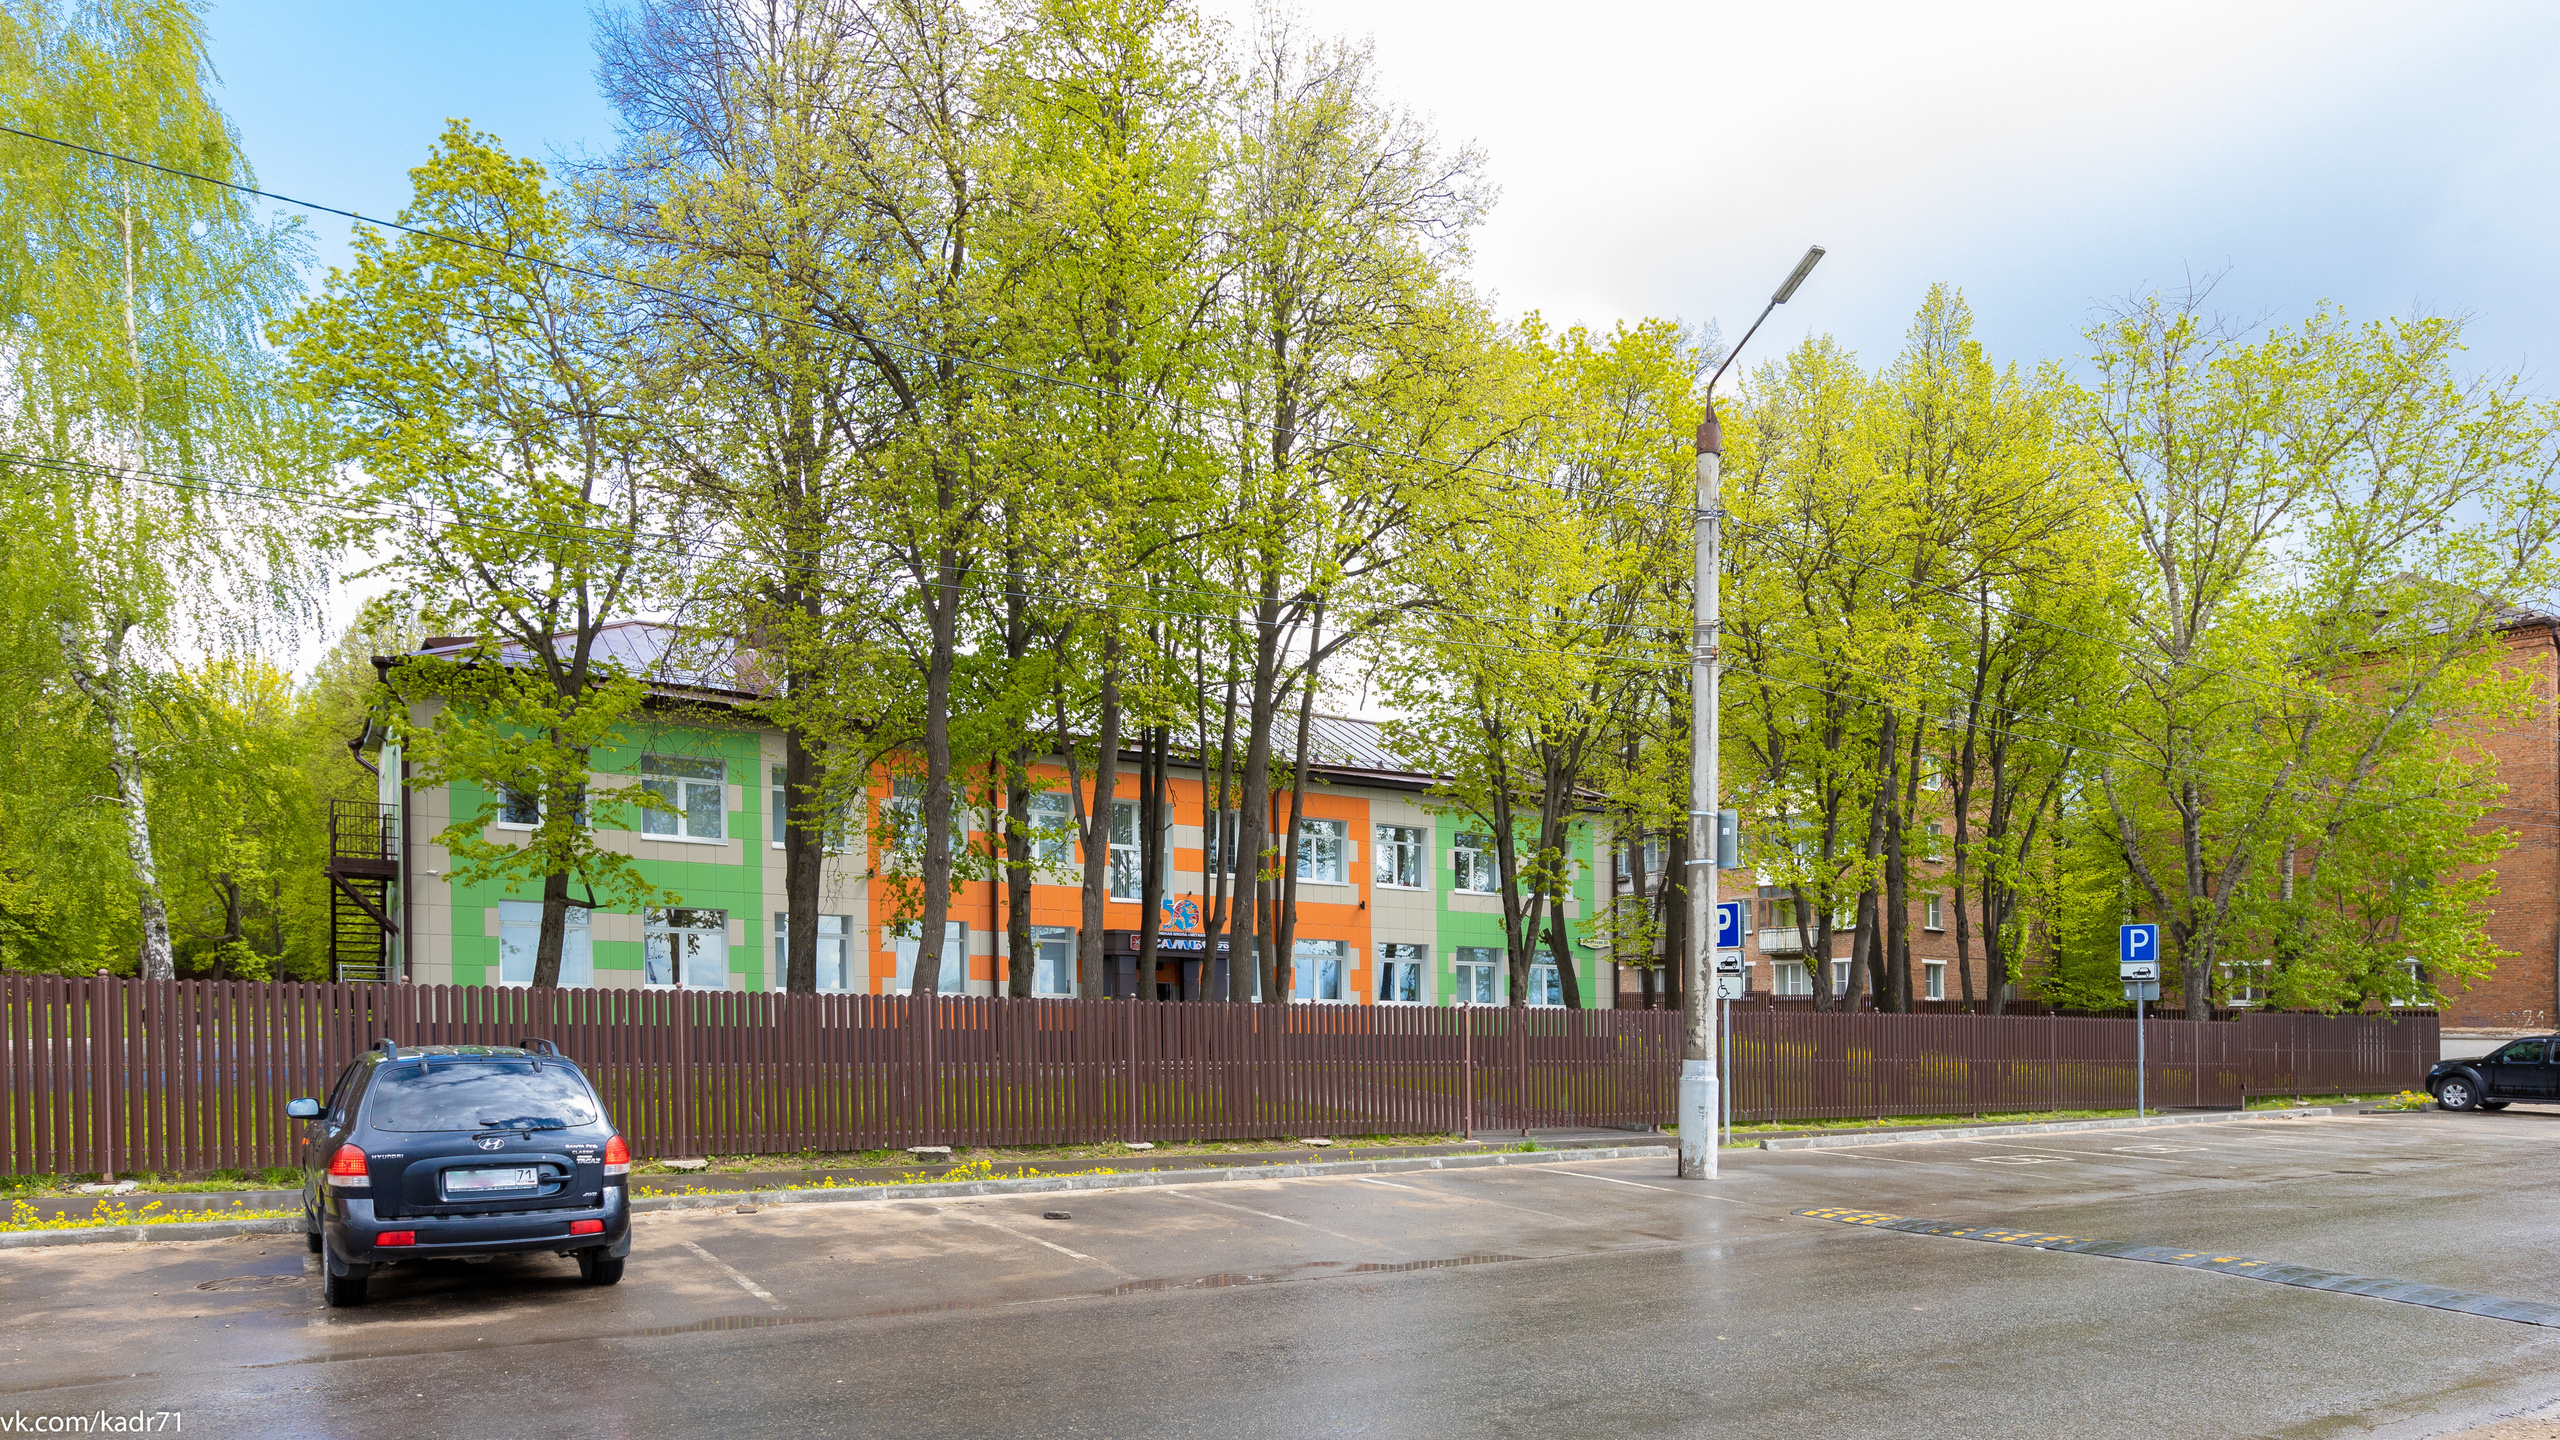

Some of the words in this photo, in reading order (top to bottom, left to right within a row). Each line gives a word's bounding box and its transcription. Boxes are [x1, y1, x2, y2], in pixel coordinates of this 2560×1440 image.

[1717, 908, 1731, 943] P
[2131, 929, 2149, 957] P
[517, 1169, 532, 1179] 71
